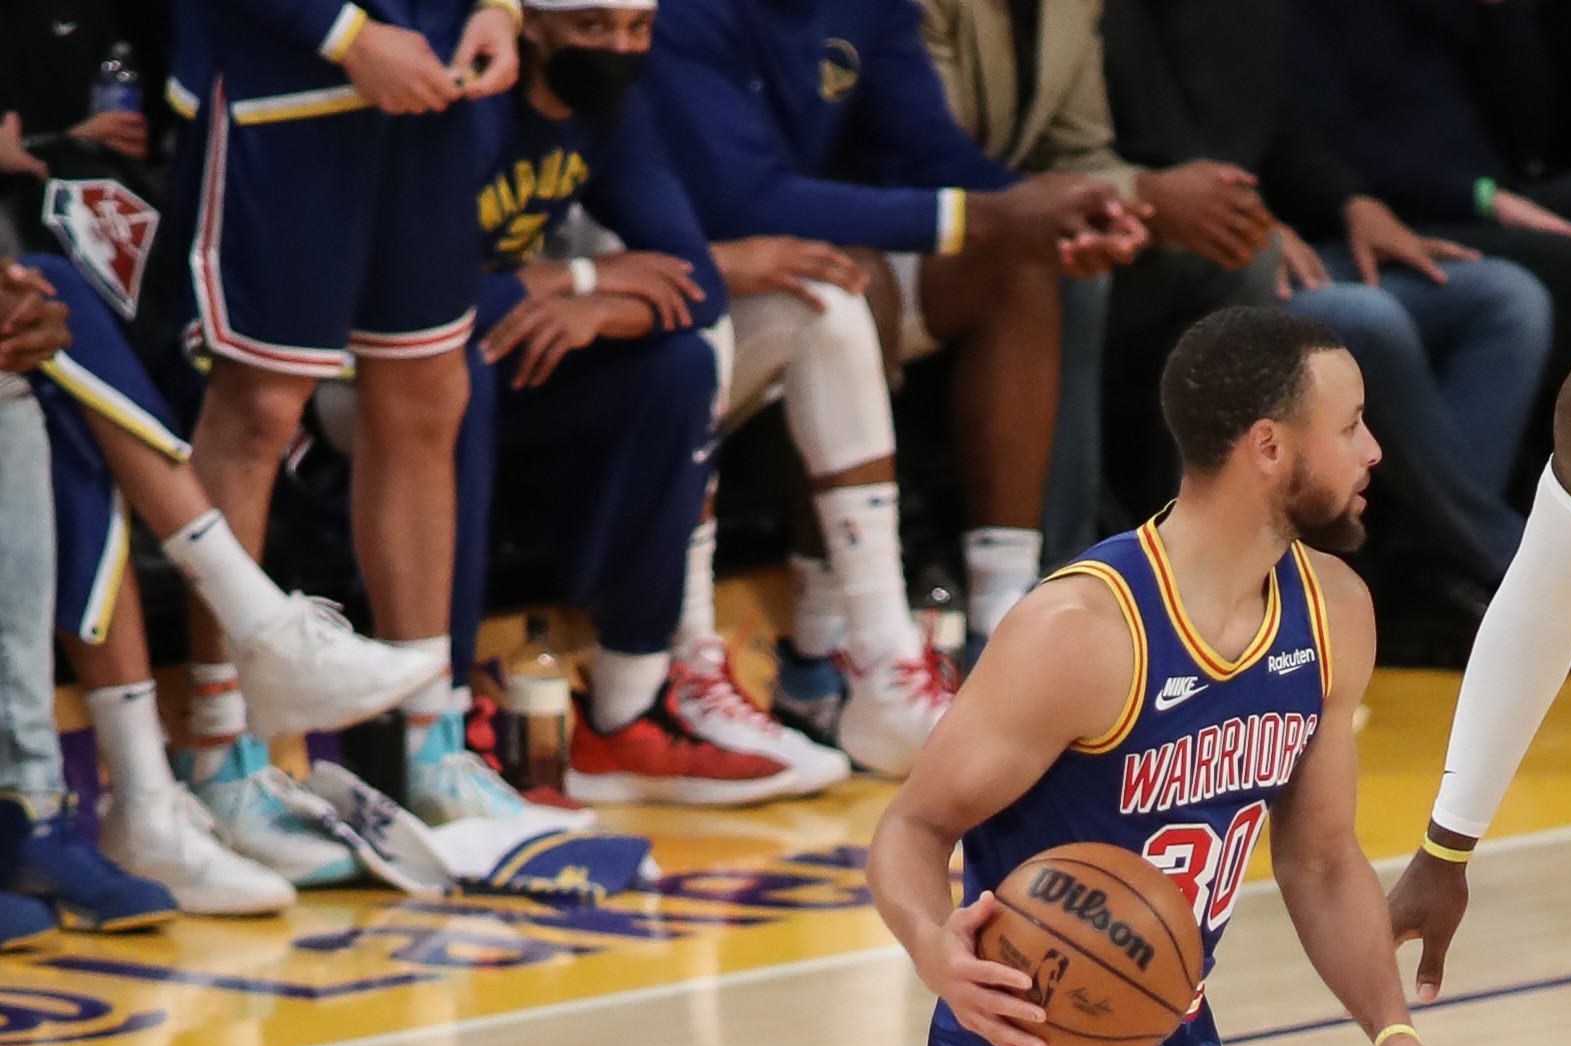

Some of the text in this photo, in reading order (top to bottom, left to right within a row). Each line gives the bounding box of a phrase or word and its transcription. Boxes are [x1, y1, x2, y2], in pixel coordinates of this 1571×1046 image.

[1268, 648, 1316, 673] Rakuten
[1162, 676, 1198, 697] NIKE
[1027, 867, 1156, 971] Wilson
